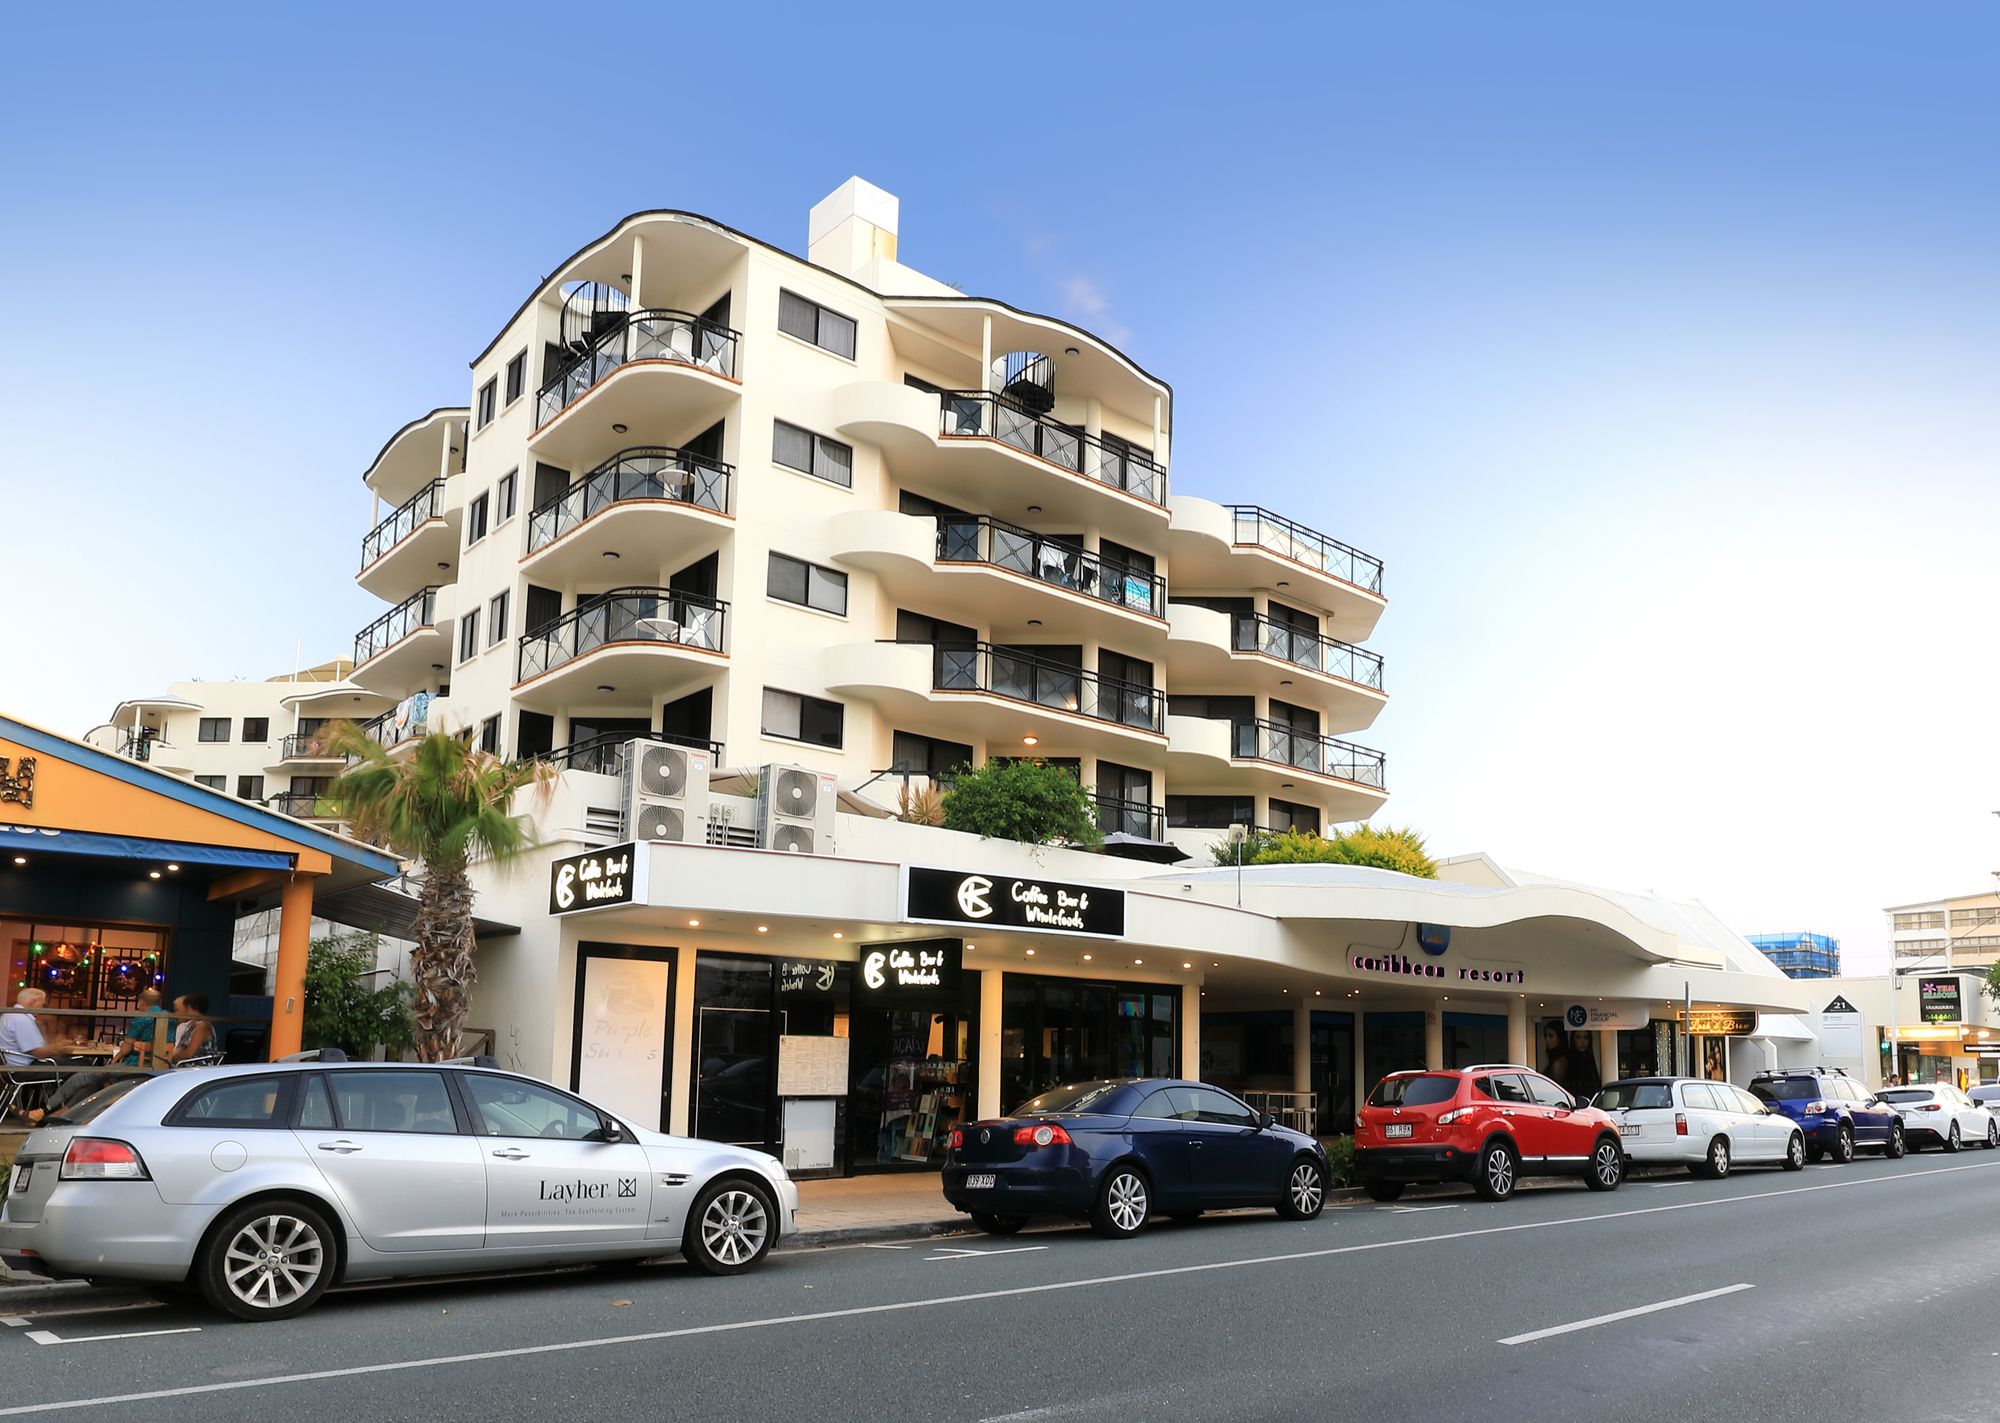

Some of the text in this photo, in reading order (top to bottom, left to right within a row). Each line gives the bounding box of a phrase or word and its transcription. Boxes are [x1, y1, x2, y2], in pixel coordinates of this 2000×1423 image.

[1011, 881, 1089, 910] Coffee Bar &
[1026, 905, 1084, 929] Wholefoods
[889, 949, 914, 968] Coffee
[1353, 954, 1524, 984] caribbean resort
[898, 968, 940, 985] Wholefoods
[1833, 1001, 1846, 1009] 21
[539, 1180, 608, 1204] Layher
